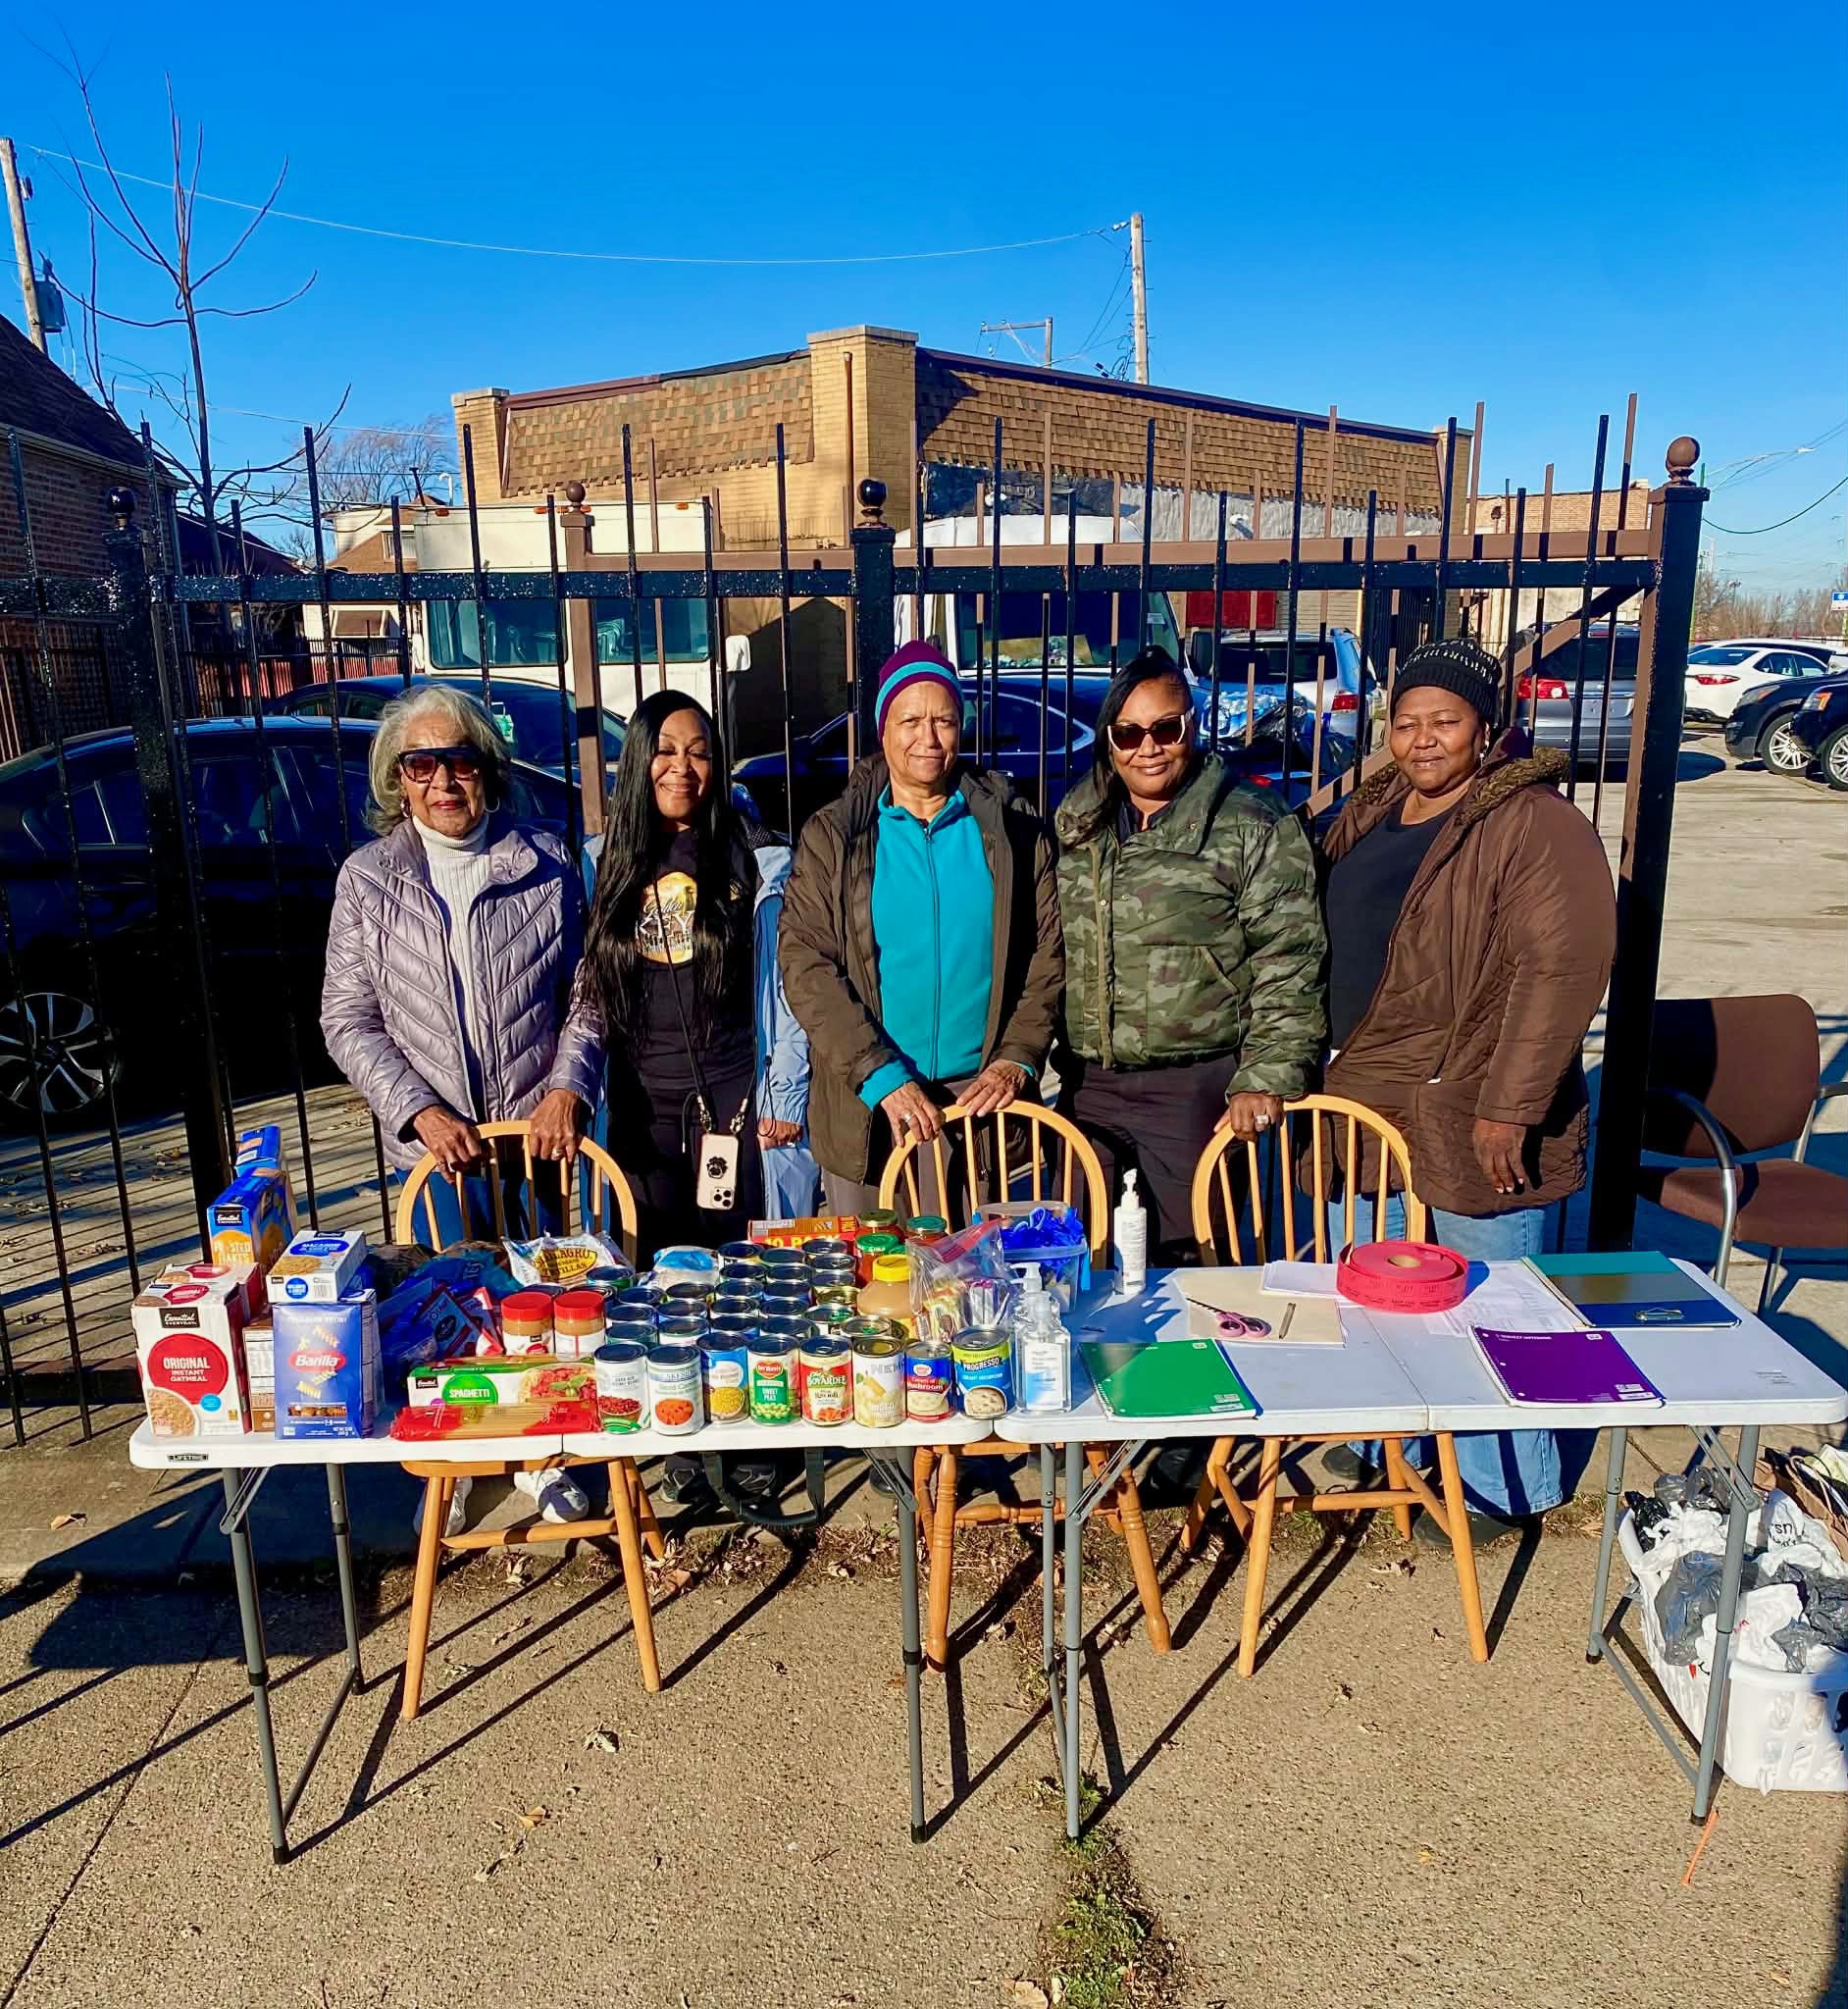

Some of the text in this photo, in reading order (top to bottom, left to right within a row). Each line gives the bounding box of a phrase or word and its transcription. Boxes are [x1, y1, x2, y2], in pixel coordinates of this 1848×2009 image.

[635, 909, 695, 940] KEY
[163, 1313, 195, 1322] Essential
[163, 1357, 212, 1370] ORIGINAL
[295, 1354, 338, 1366] Barilla
[962, 1358, 1000, 1371] PROGRESSO
[906, 1380, 944, 1391] Mushroom
[448, 1388, 490, 1398] SPAGHETTI
